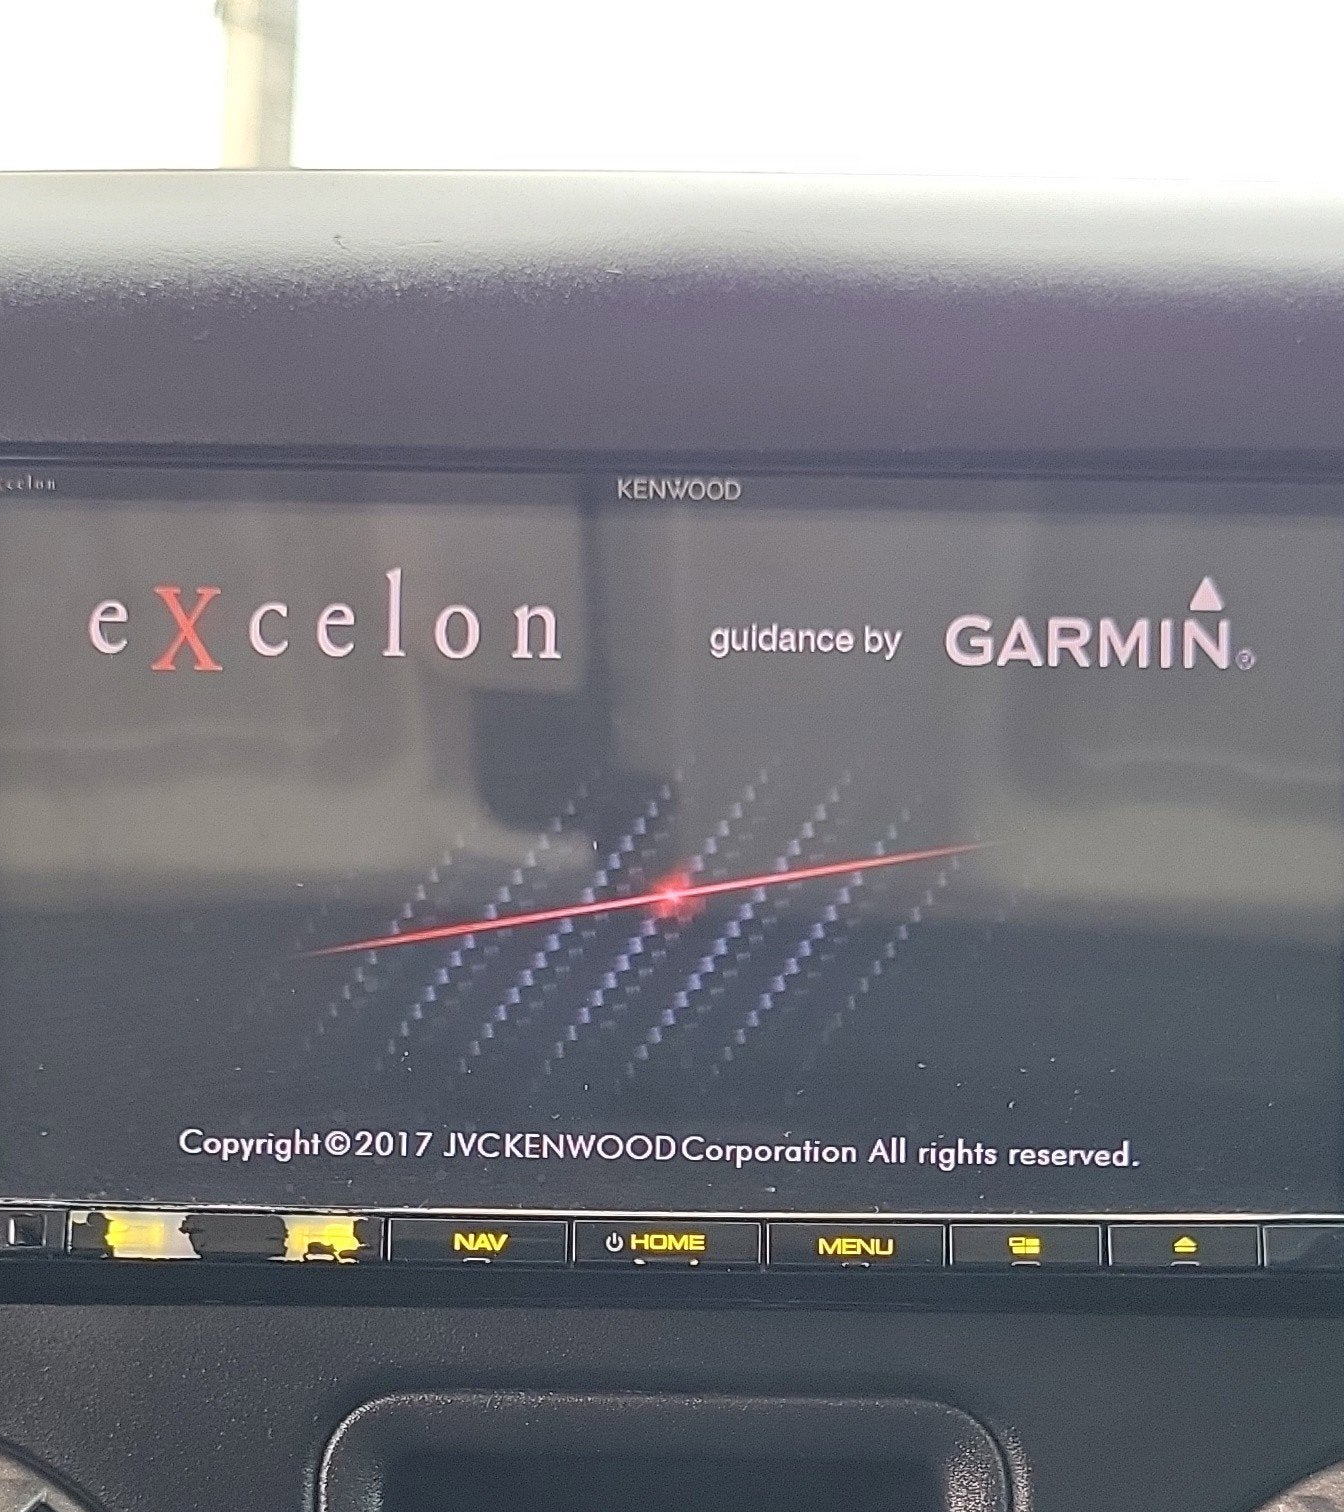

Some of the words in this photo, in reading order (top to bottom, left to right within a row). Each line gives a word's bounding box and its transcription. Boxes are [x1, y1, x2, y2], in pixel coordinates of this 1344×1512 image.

[617, 477, 742, 501] KENWOOD
[709, 624, 854, 658] guidance
[864, 623, 903, 660] by
[682, 1135, 857, 1168] Corporation
[869, 1138, 906, 1163] All
[918, 1136, 998, 1172] rights
[1008, 1140, 1141, 1168] reserved.
[453, 1232, 509, 1253] NAV
[630, 1234, 706, 1252] HOME
[817, 1236, 895, 1256] MENU
